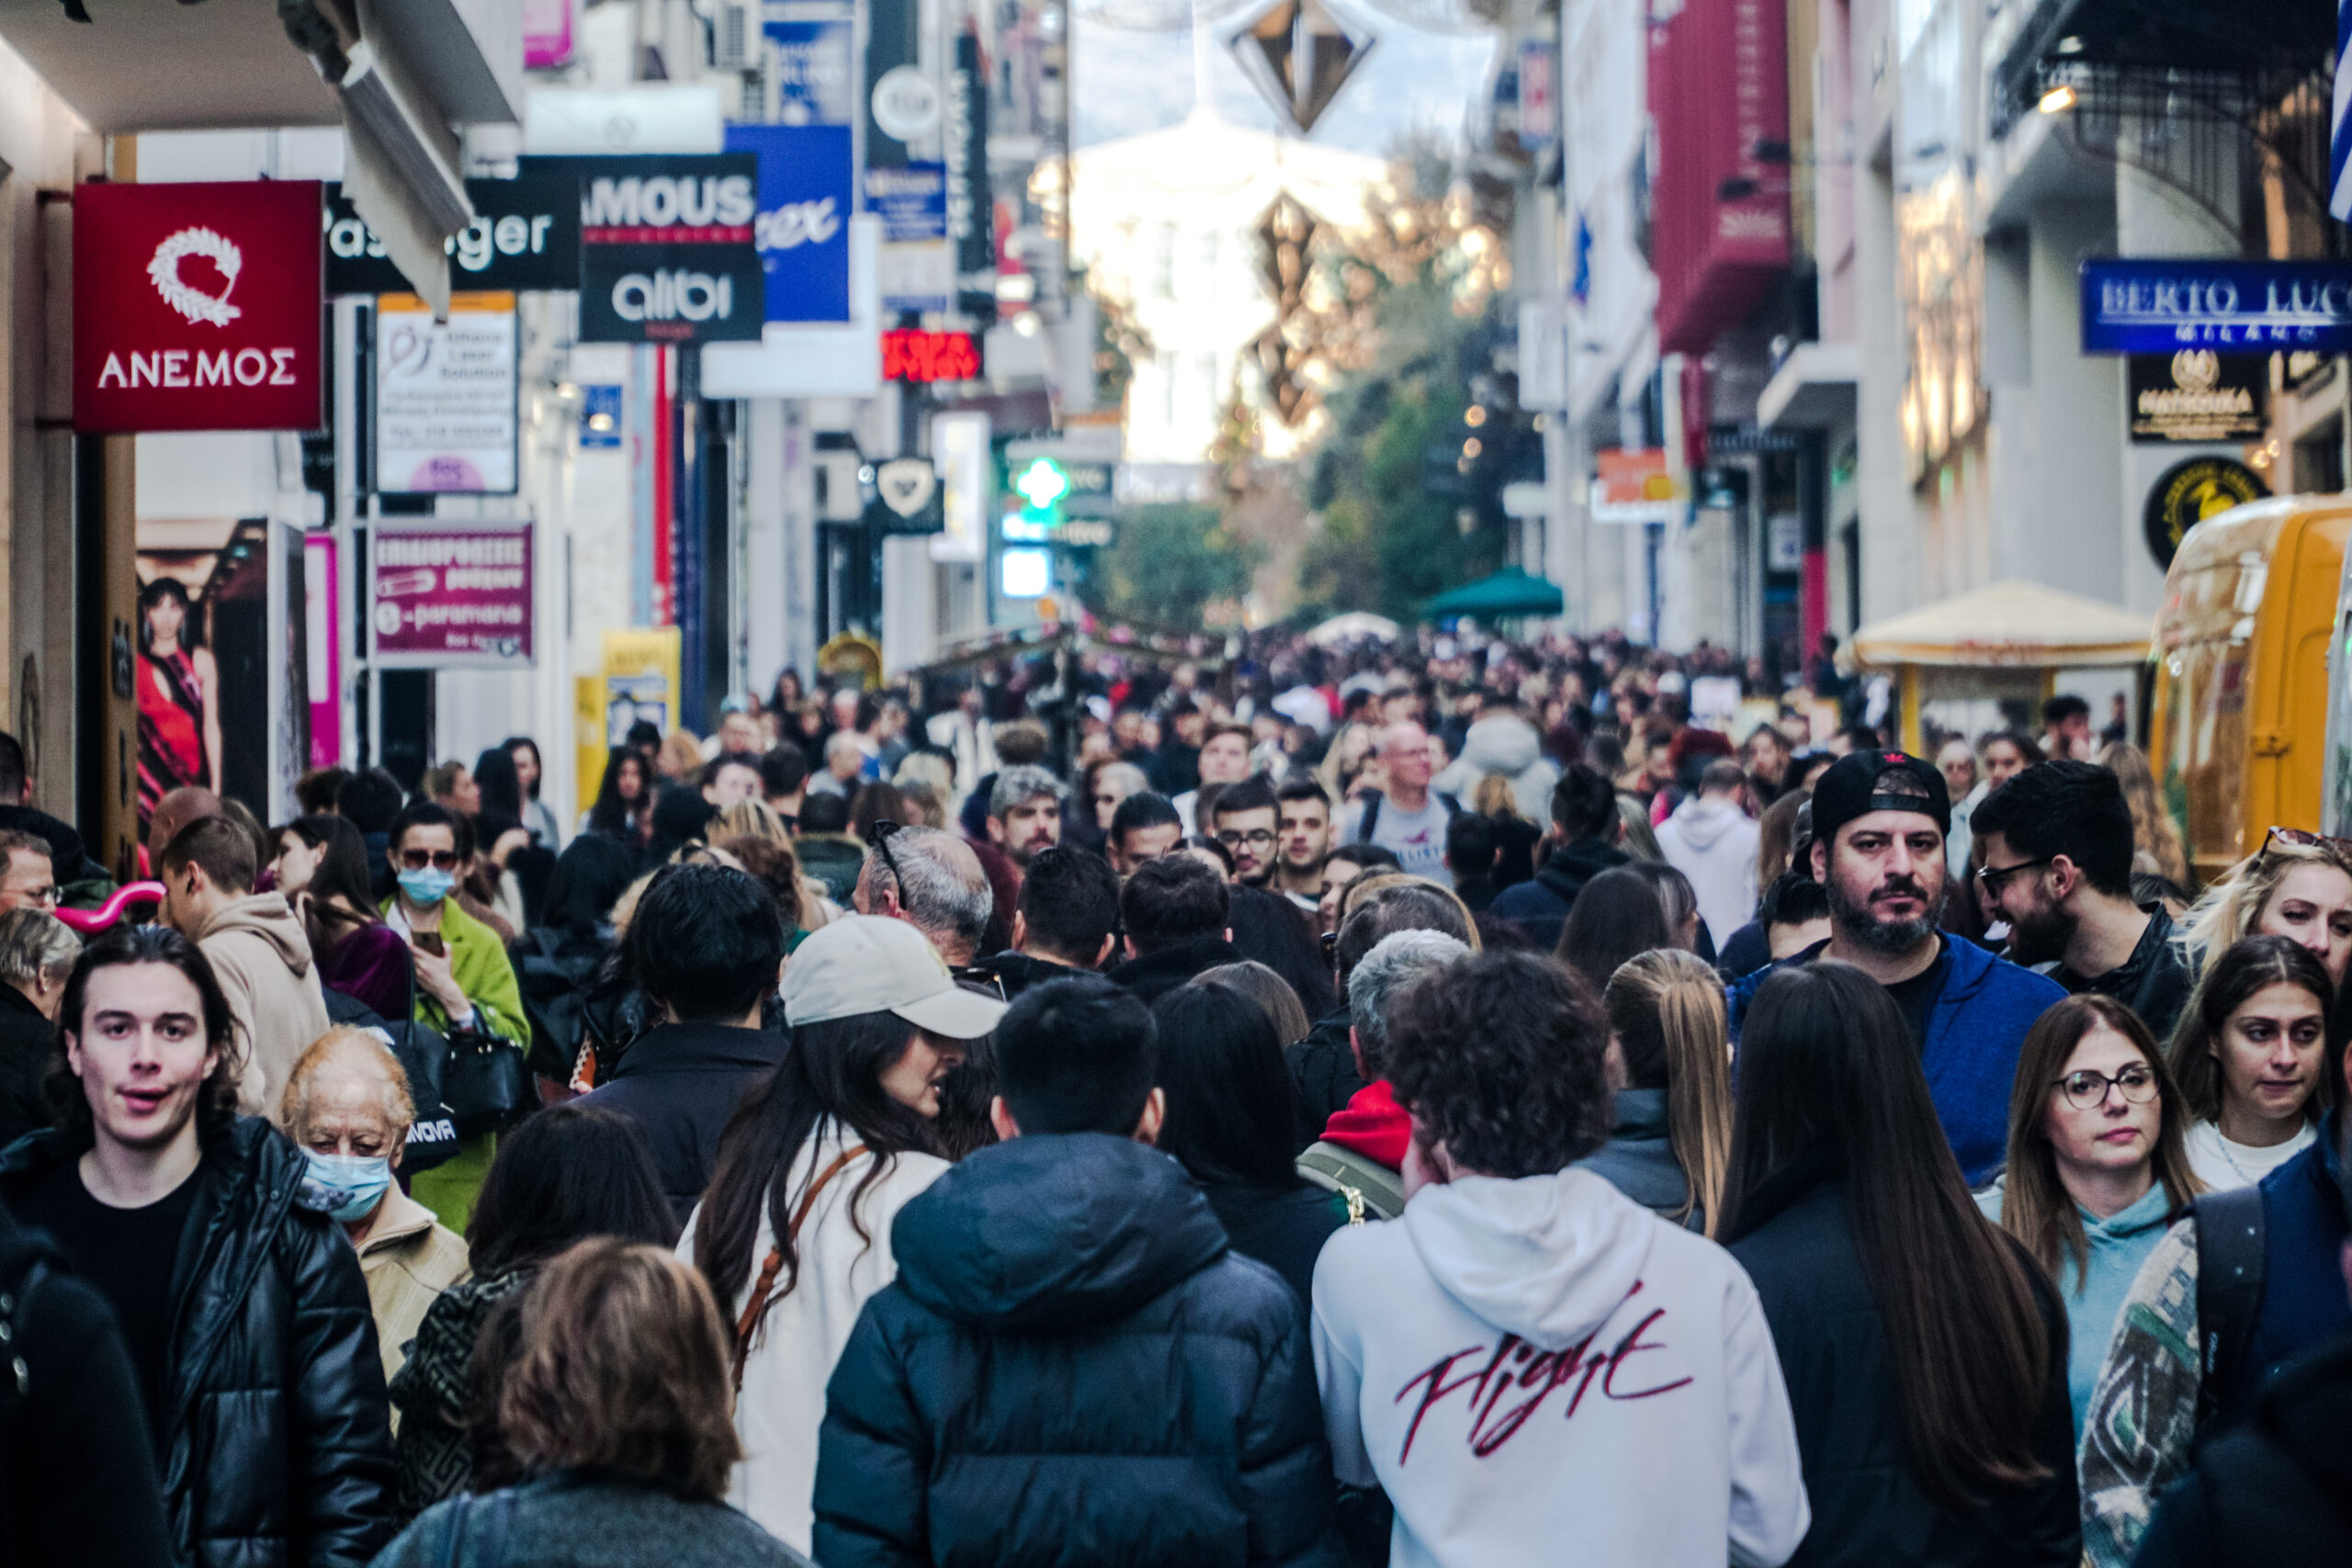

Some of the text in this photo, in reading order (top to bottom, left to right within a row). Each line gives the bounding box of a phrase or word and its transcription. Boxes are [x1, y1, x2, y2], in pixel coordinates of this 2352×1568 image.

[581, 175, 755, 227] MOUS
[2100, 277, 2352, 316] BERTO LUC
[97, 347, 296, 389] ΑΝΕΜΟΣ
[1393, 1280, 1694, 1468] Flight
